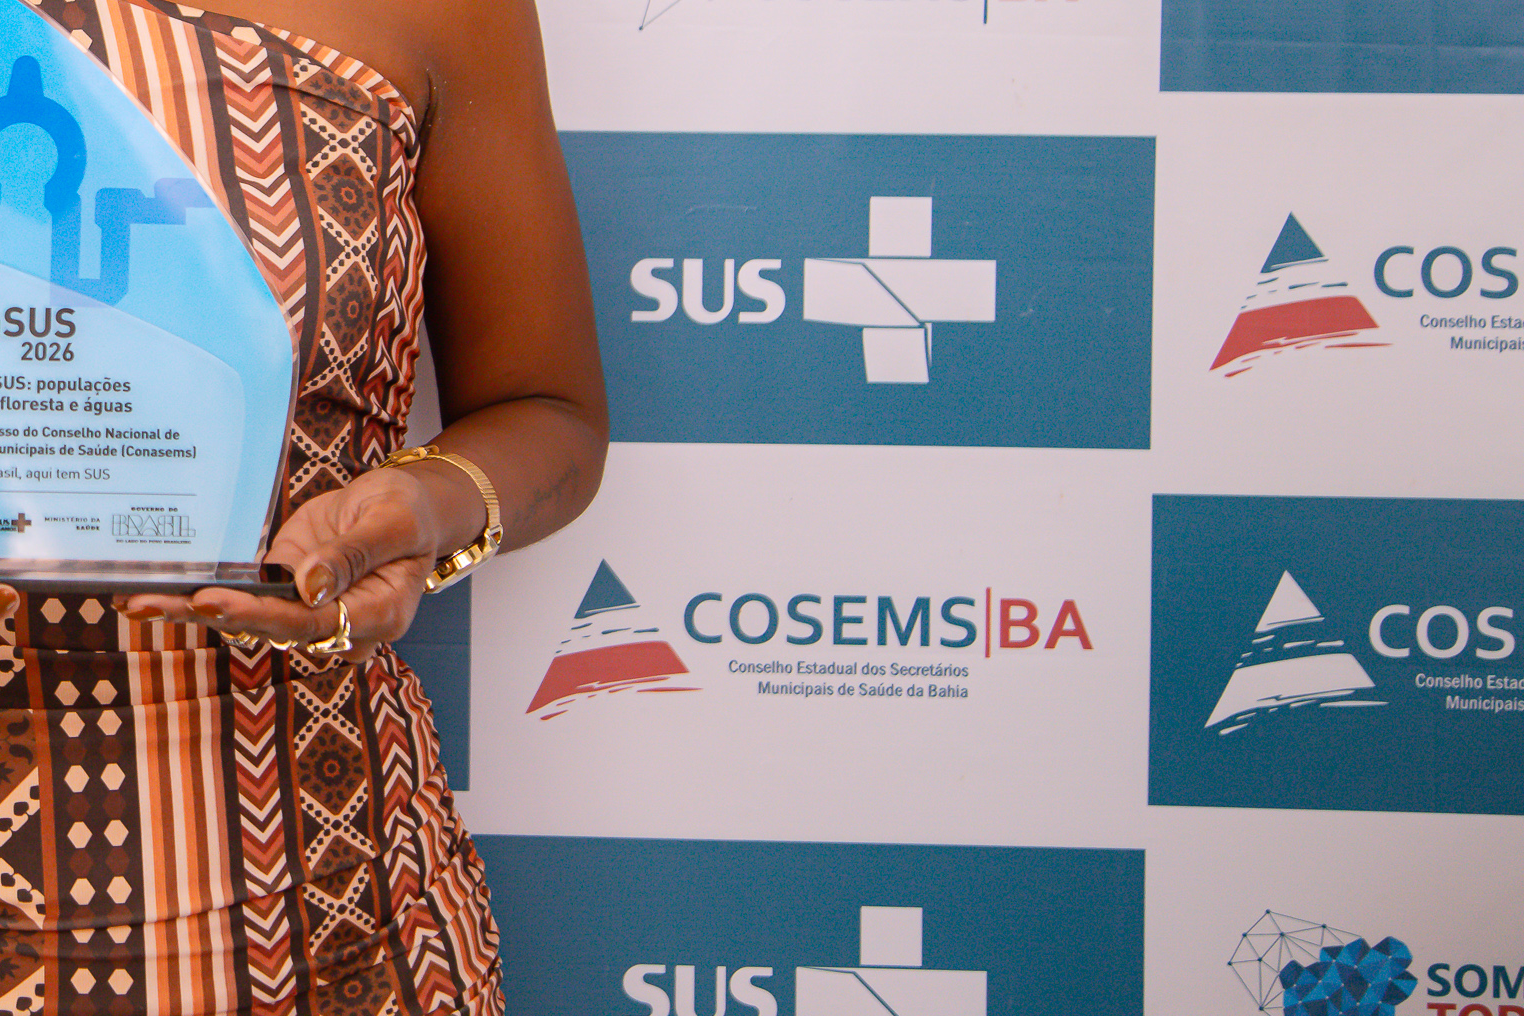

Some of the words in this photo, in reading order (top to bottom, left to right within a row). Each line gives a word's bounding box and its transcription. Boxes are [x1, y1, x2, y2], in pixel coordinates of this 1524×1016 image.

[630, 258, 786, 324] SUS
[1420, 314, 1486, 328] Conselho
[21, 342, 74, 362] 2026
[37, 378, 130, 395] populações
[0, 396, 64, 411] floresta
[70, 401, 78, 412] e
[84, 397, 132, 416] águas
[23, 426, 38, 437] do
[42, 426, 101, 438] Conselho
[106, 428, 160, 439] Nacional
[165, 430, 180, 440] de
[59, 445, 74, 455] de
[78, 445, 117, 456] Saúde
[122, 445, 196, 458] (Conasems)
[26, 470, 52, 481] aqui
[56, 469, 80, 479] tem
[84, 468, 110, 480] SUS
[112, 515, 196, 537] BRASIL
[729, 660, 792, 674] Conselho
[797, 661, 857, 675] Estadual
[861, 662, 886, 676] dos
[890, 662, 969, 677] Secretários
[1416, 673, 1482, 688] Conselho
[758, 681, 834, 697] Municipais
[838, 683, 854, 696] de
[859, 683, 902, 697] Saúde
[907, 684, 923, 697] da
[928, 684, 968, 698] Bahia
[1428, 963, 1524, 999] SOM
[623, 964, 777, 1016] SUS
